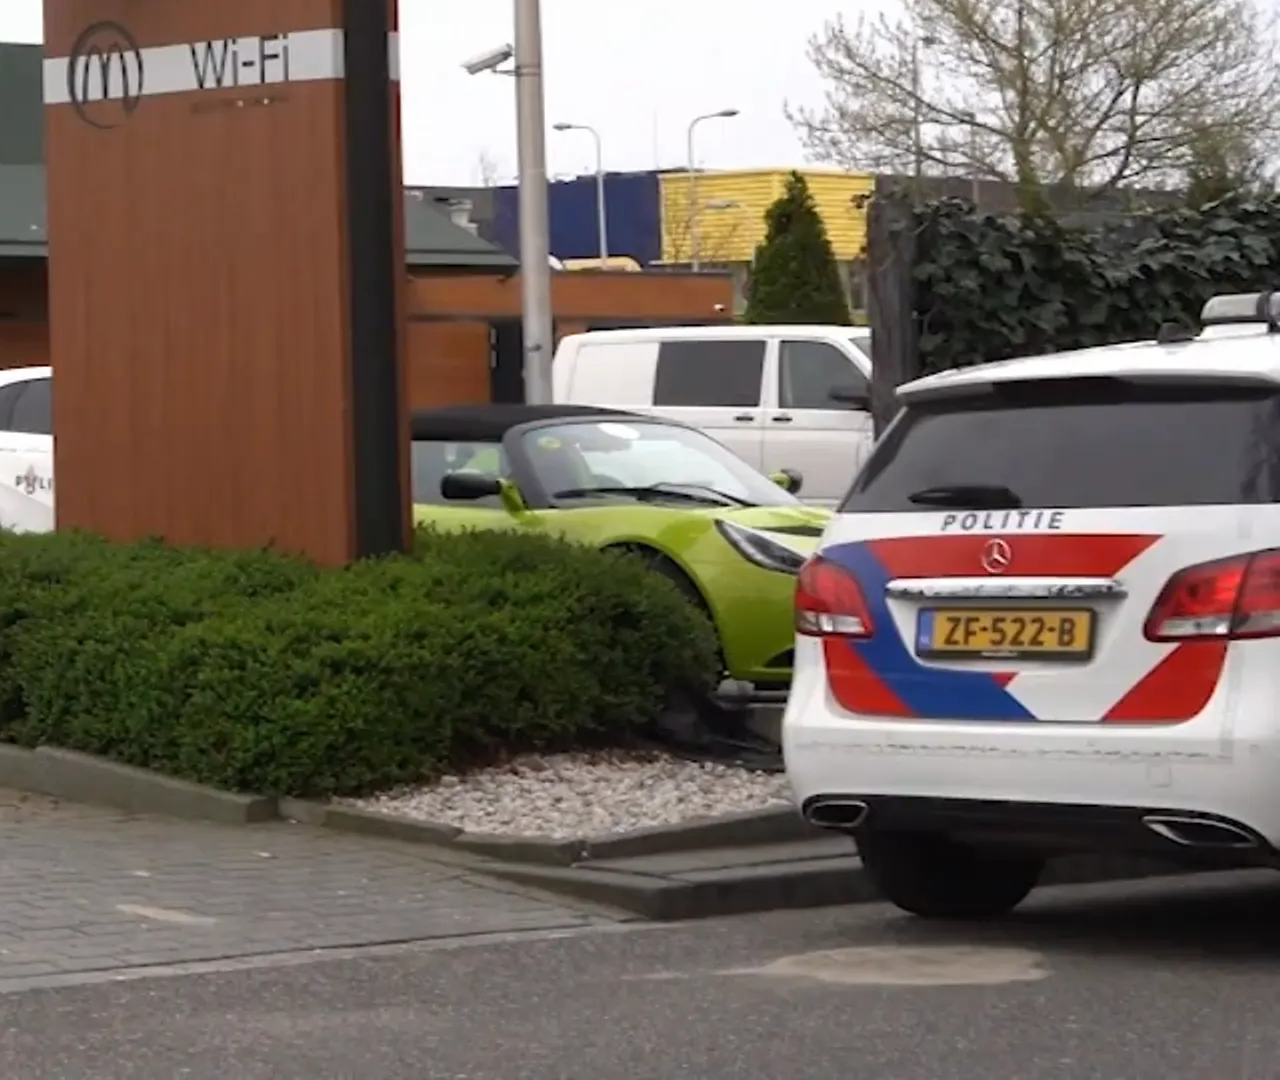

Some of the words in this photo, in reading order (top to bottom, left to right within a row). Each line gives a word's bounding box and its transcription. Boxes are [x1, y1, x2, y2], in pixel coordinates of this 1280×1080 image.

[190, 33, 289, 89] Wi-Fi
[940, 511, 1065, 531] POLITIE
[943, 616, 1077, 647] ZF-522-B
